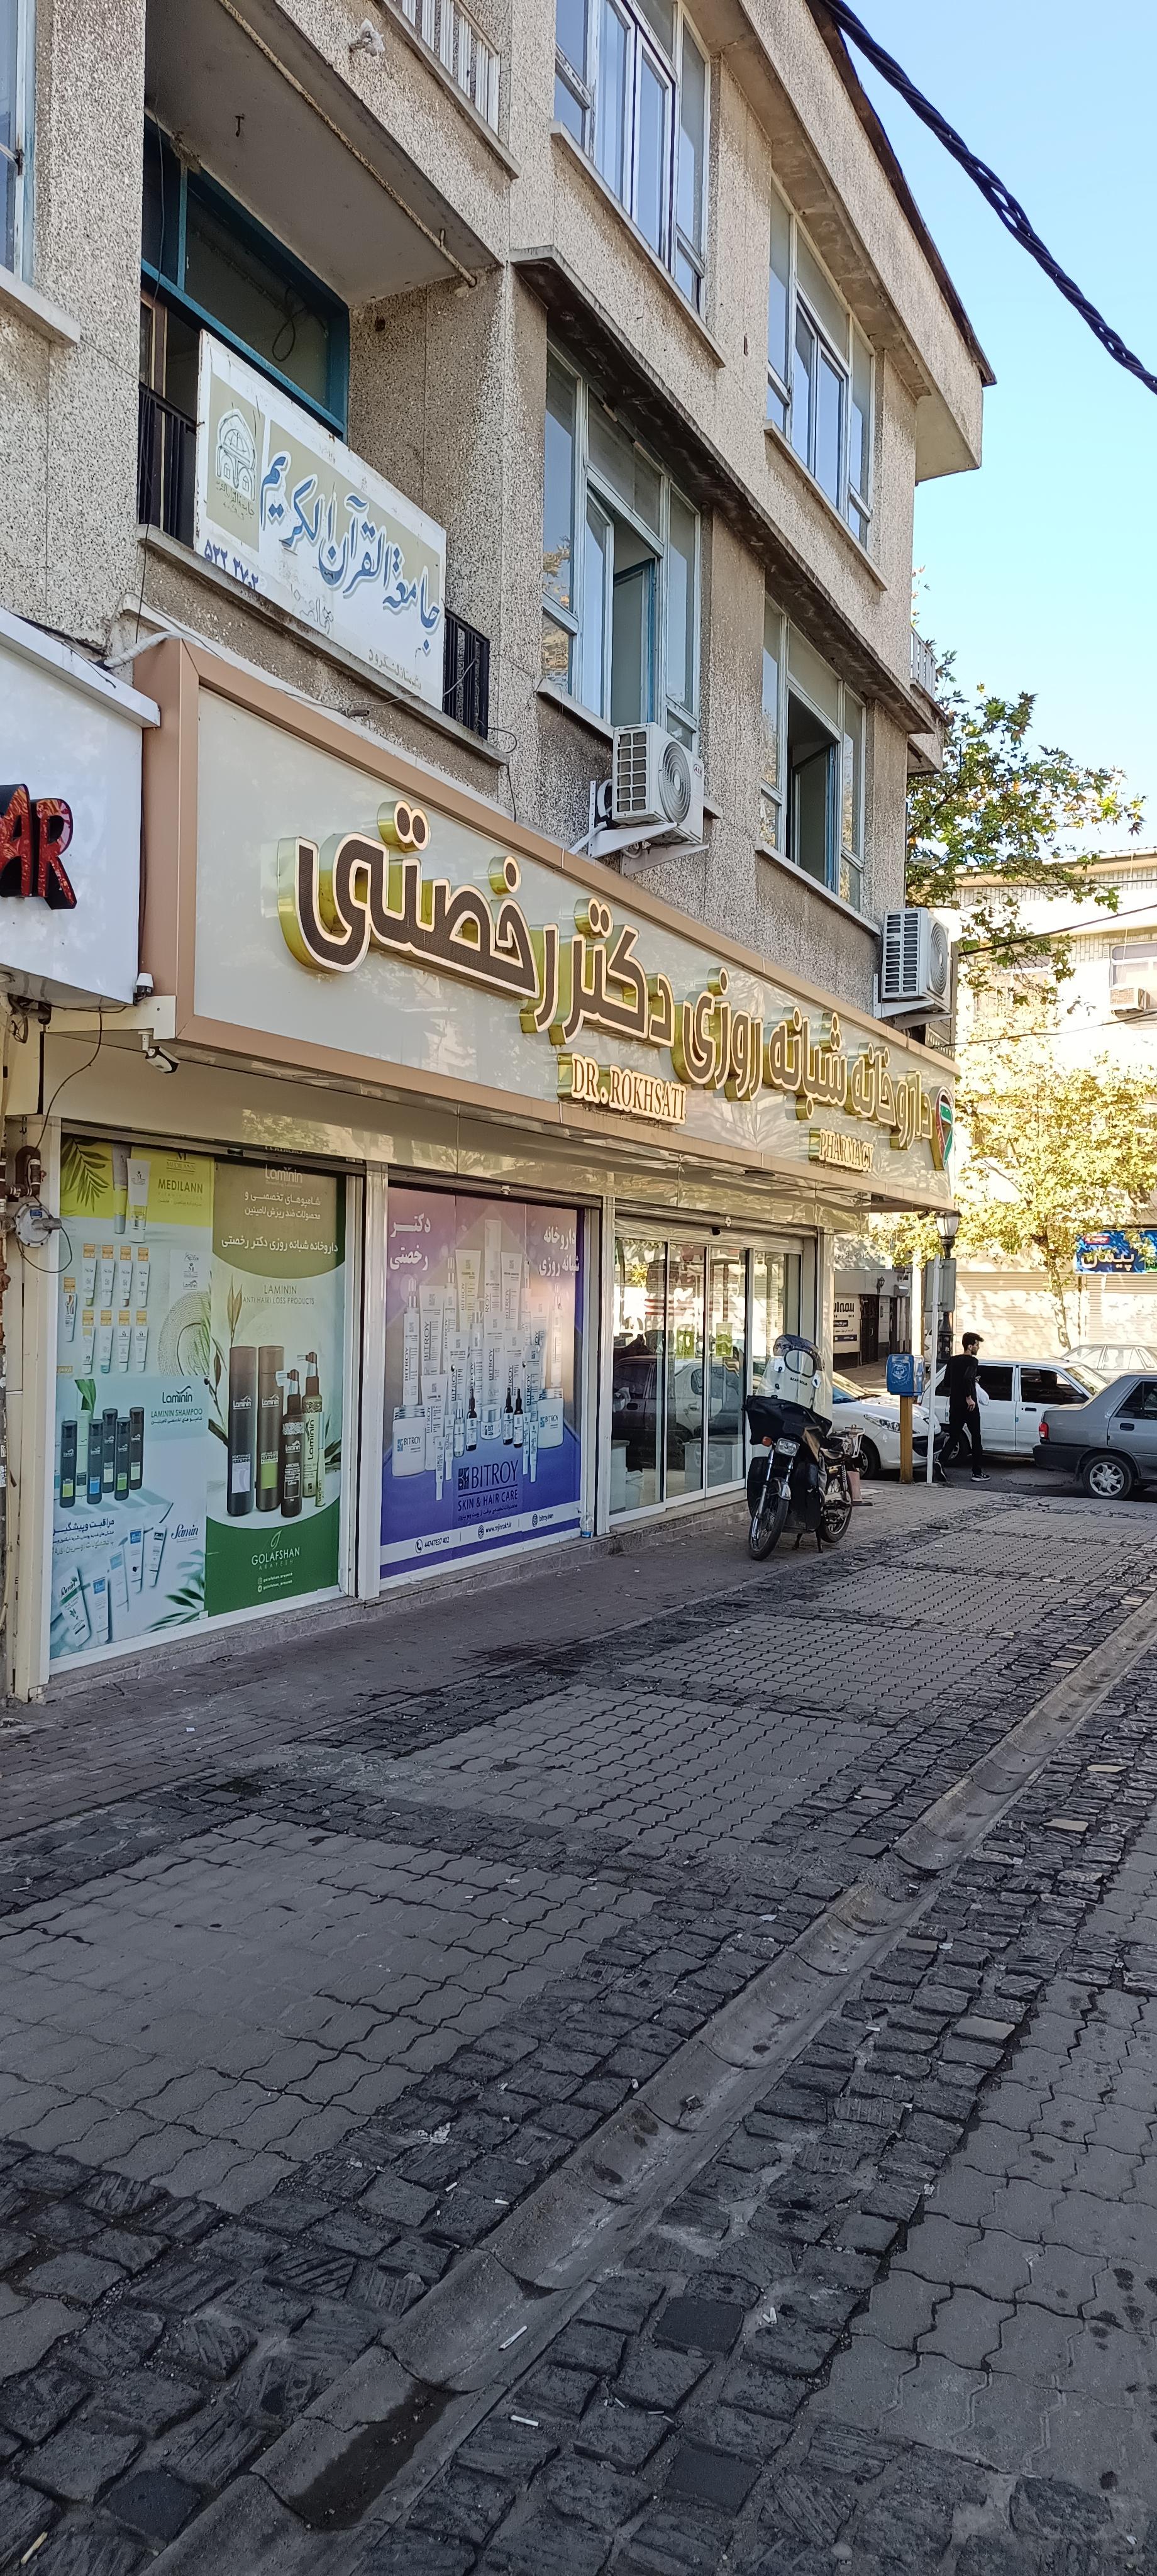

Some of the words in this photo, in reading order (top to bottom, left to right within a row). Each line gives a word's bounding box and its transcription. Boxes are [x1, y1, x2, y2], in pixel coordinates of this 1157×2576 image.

[283, 801, 559, 1035] رخصتی
[556, 898, 674, 1047] دکتر
[679, 967, 763, 1102] روزی
[769, 1006, 848, 1120] شبانه
[572, 1056, 607, 1102] DR.
[610, 1067, 686, 1123] ROKHSATI
[851, 1043, 933, 1150] داروخانه
[819, 1130, 873, 1170] PHARMACY
[265, 1164, 303, 1183] Laminin
[158, 1178, 204, 1194] MEDILANN
[390, 1213, 431, 1238] دکتر
[221, 1235, 249, 1249] رخصتی
[251, 1236, 268, 1250] دکتر
[270, 1238, 288, 1252] روزی
[289, 1239, 309, 1252] شبانه
[310, 1241, 338, 1255] داروخانه
[543, 1226, 575, 1250] داروخانه
[389, 1245, 428, 1271] رخصتی
[539, 1257, 560, 1277] روزی
[562, 1255, 580, 1276] شبانه
[264, 1284, 297, 1294] LAMININ
[162, 1389, 193, 1404] Laminin
[151, 1410, 174, 1418] LAMININ
[175, 1408, 202, 1416] SHAMPOO
[404, 1436, 421, 1446] BITROY
[472, 1460, 519, 1489] BITROY
[458, 1498, 474, 1512] SKIN
[477, 1497, 481, 1507] &
[484, 1493, 499, 1506] HAIR
[502, 1489, 518, 1502] CARE
[252, 1547, 300, 1565] GOLAFSHAN
